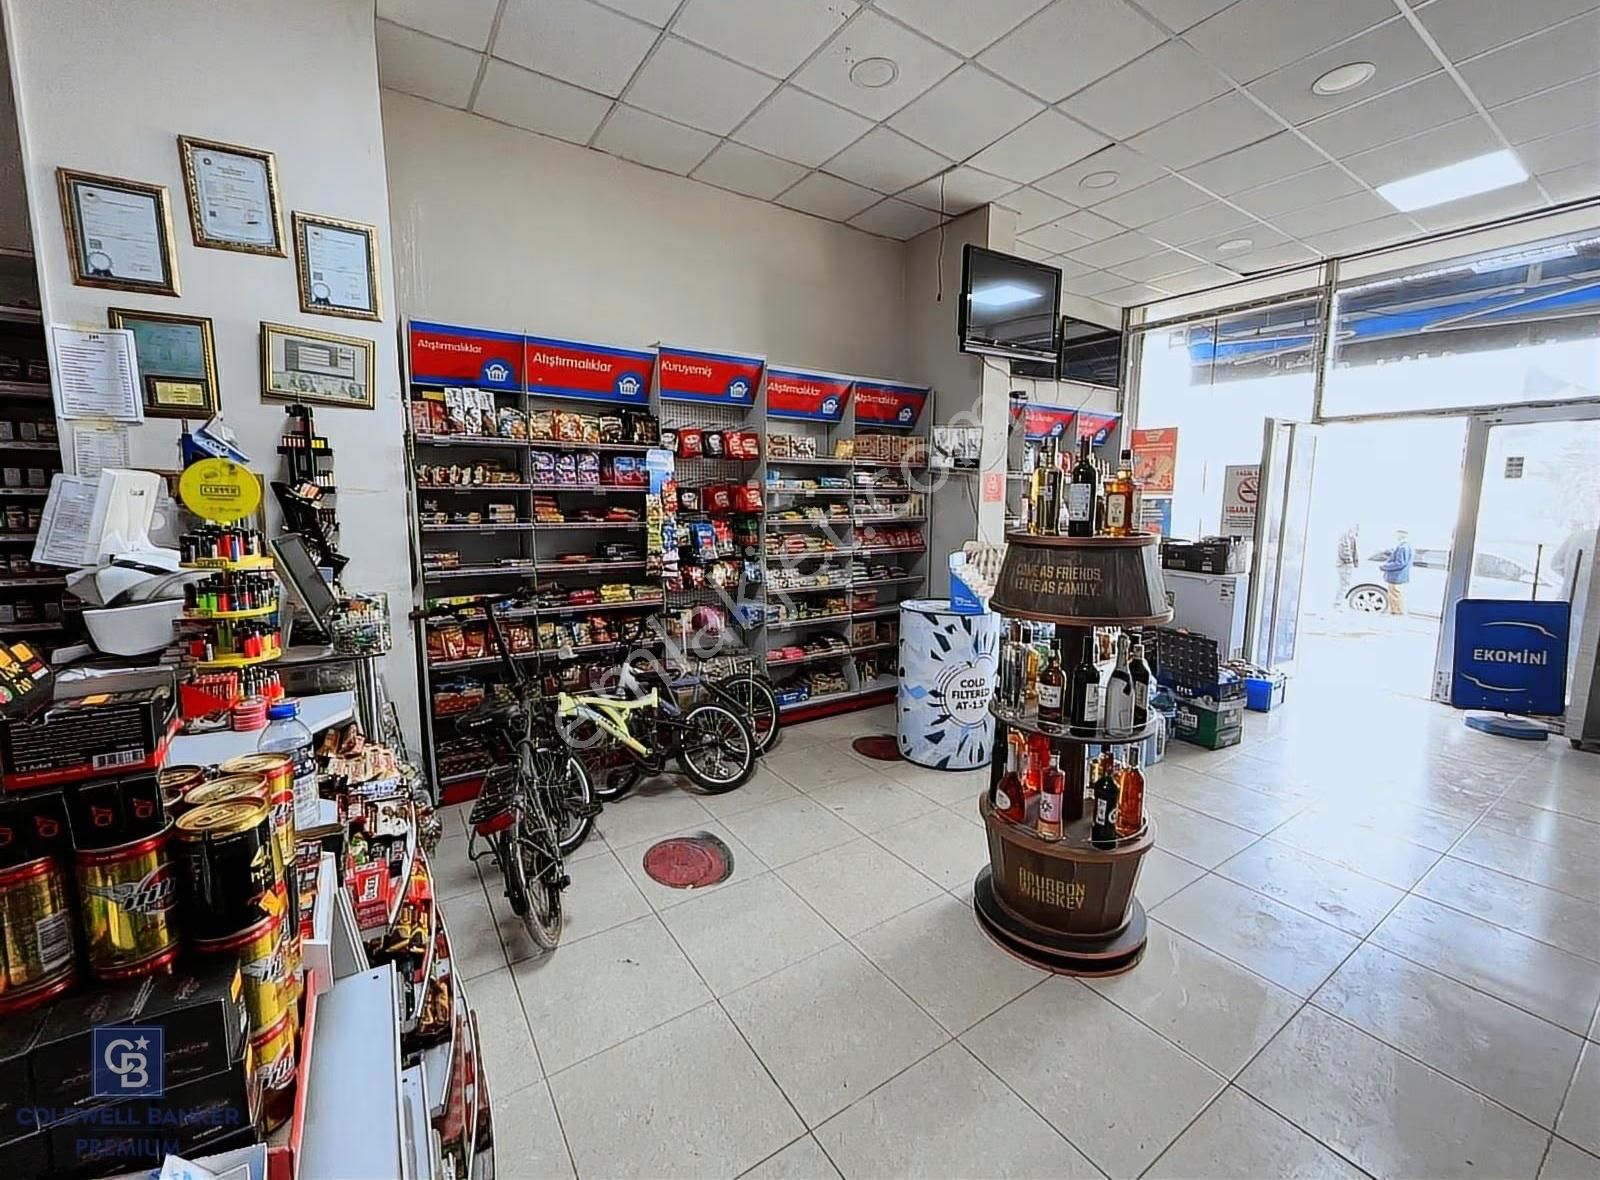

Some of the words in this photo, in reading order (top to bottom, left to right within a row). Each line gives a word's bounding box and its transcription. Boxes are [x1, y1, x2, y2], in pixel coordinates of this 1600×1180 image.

[417, 338, 482, 354] Atıştırmalıklar
[532, 352, 613, 373] Atıştırmalıklar
[661, 359, 713, 379] Kuruyemiş
[1040, 566, 1053, 578] AS
[1041, 581, 1055, 594] AS
[1473, 649, 1547, 665] EKOMİNİ
[960, 678, 985, 689] COLD
[951, 687, 990, 700] FILTERED
[1019, 866, 1085, 897] BOURBON
[1020, 881, 1085, 910] WHISKEY
